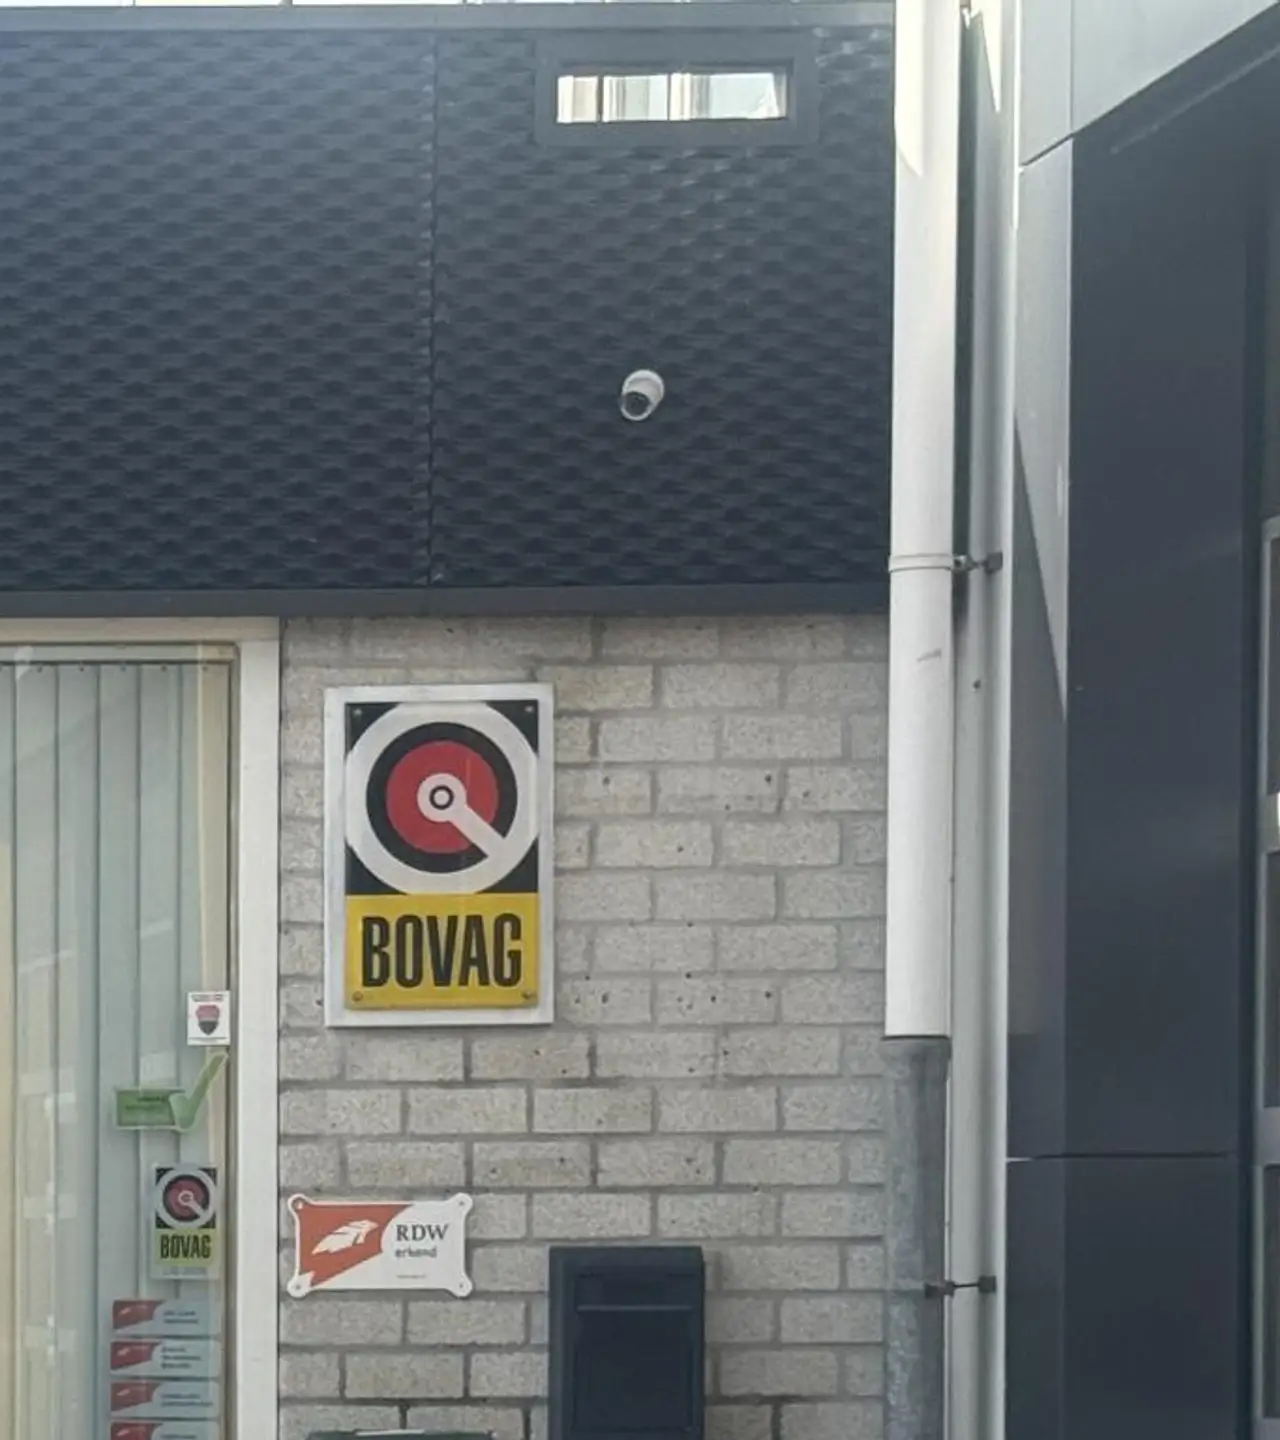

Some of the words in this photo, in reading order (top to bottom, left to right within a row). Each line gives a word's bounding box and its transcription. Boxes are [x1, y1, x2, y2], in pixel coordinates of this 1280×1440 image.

[362, 913, 522, 988] BOVAG
[396, 1223, 449, 1242] RDW
[160, 1234, 212, 1259] BOVAG
